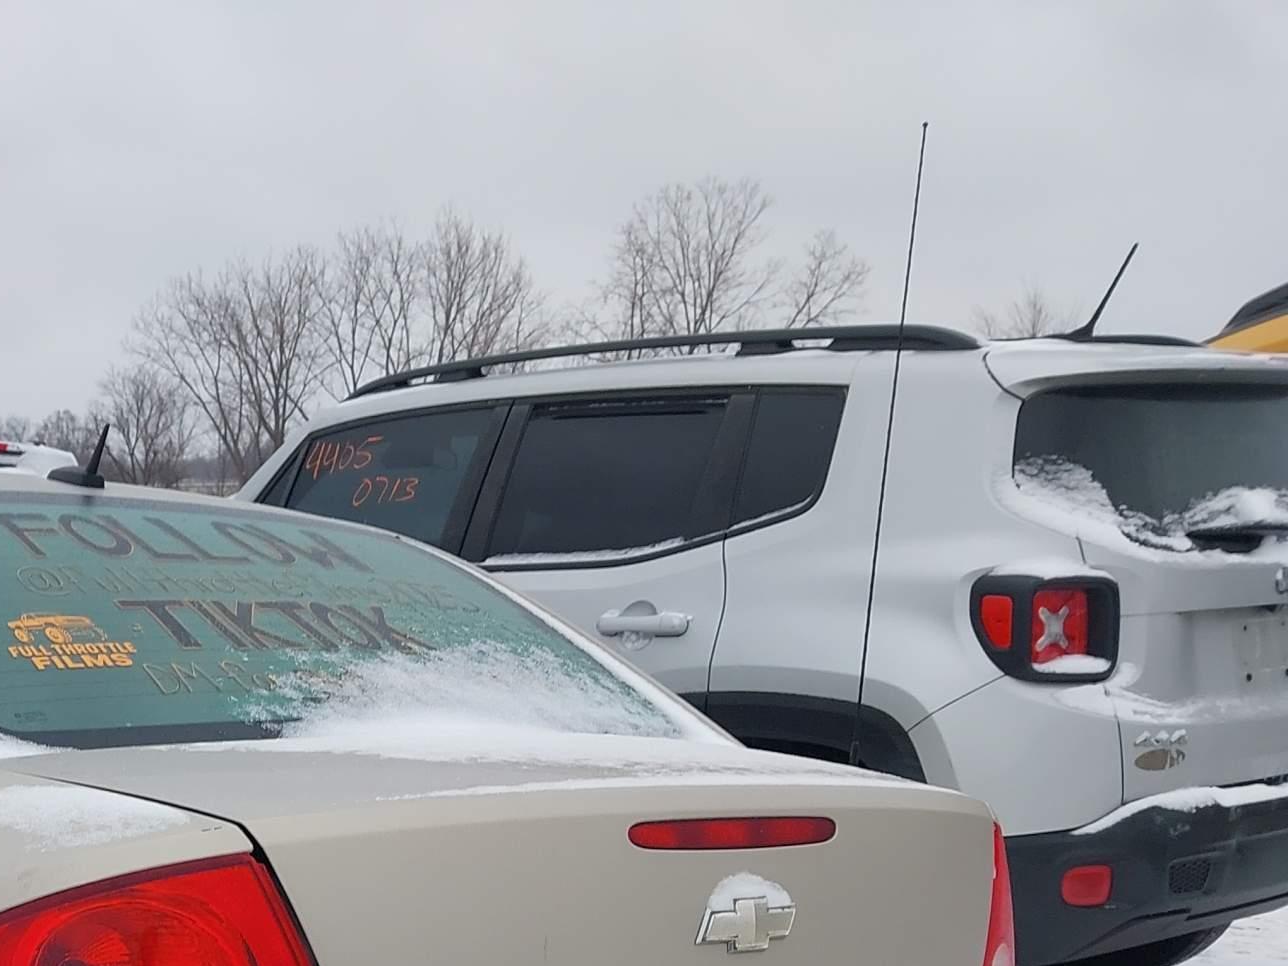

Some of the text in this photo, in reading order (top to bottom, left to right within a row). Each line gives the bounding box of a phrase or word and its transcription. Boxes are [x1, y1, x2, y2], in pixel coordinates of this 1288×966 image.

[306, 435, 384, 480] 4405
[352, 476, 419, 507] 0713
[114, 599, 438, 652] TIKTOK
[8, 642, 137, 657] FULL THROTTLE
[32, 653, 133, 671] FILMS
